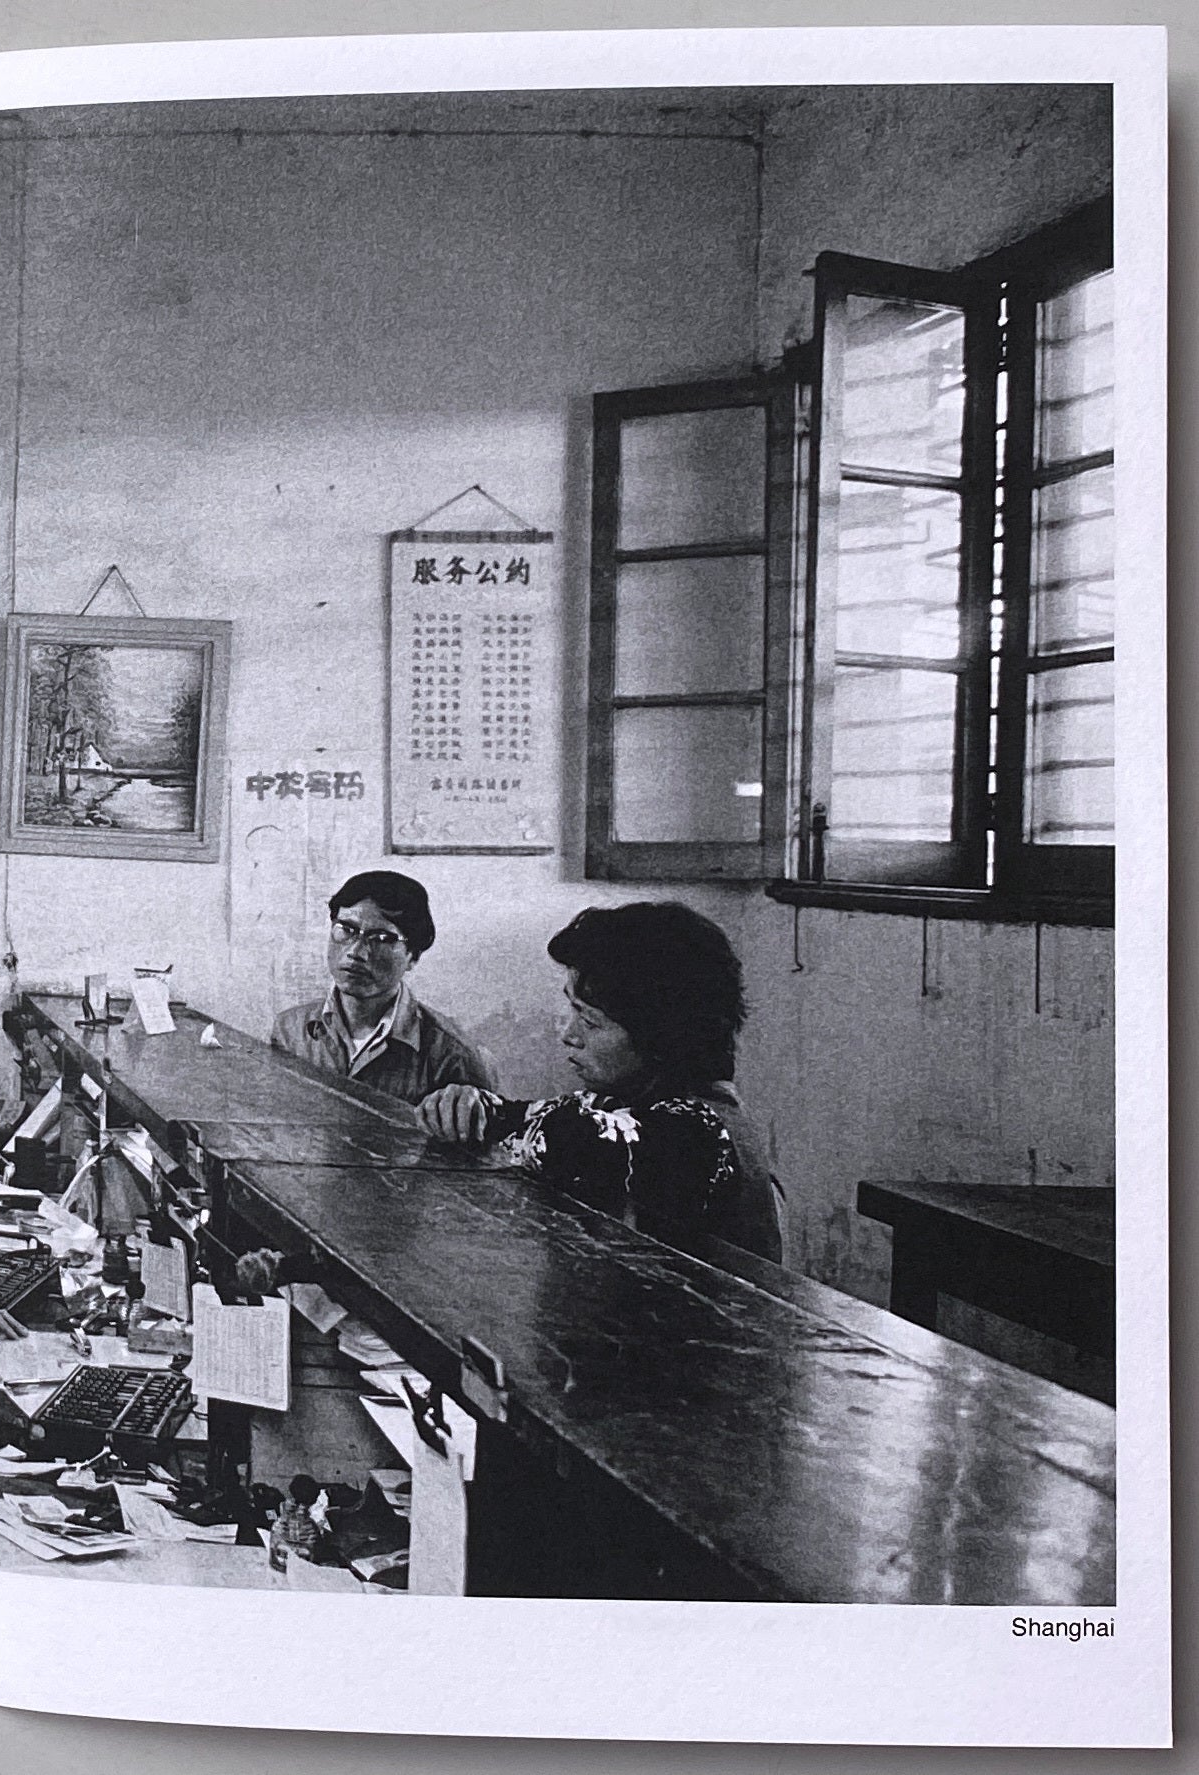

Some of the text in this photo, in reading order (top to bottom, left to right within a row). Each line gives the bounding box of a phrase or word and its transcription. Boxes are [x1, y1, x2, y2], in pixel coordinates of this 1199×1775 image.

[412, 556, 530, 585] 服务公约
[246, 769, 365, 801] 中奖号码
[1012, 1617, 1115, 1642] Shanghai
